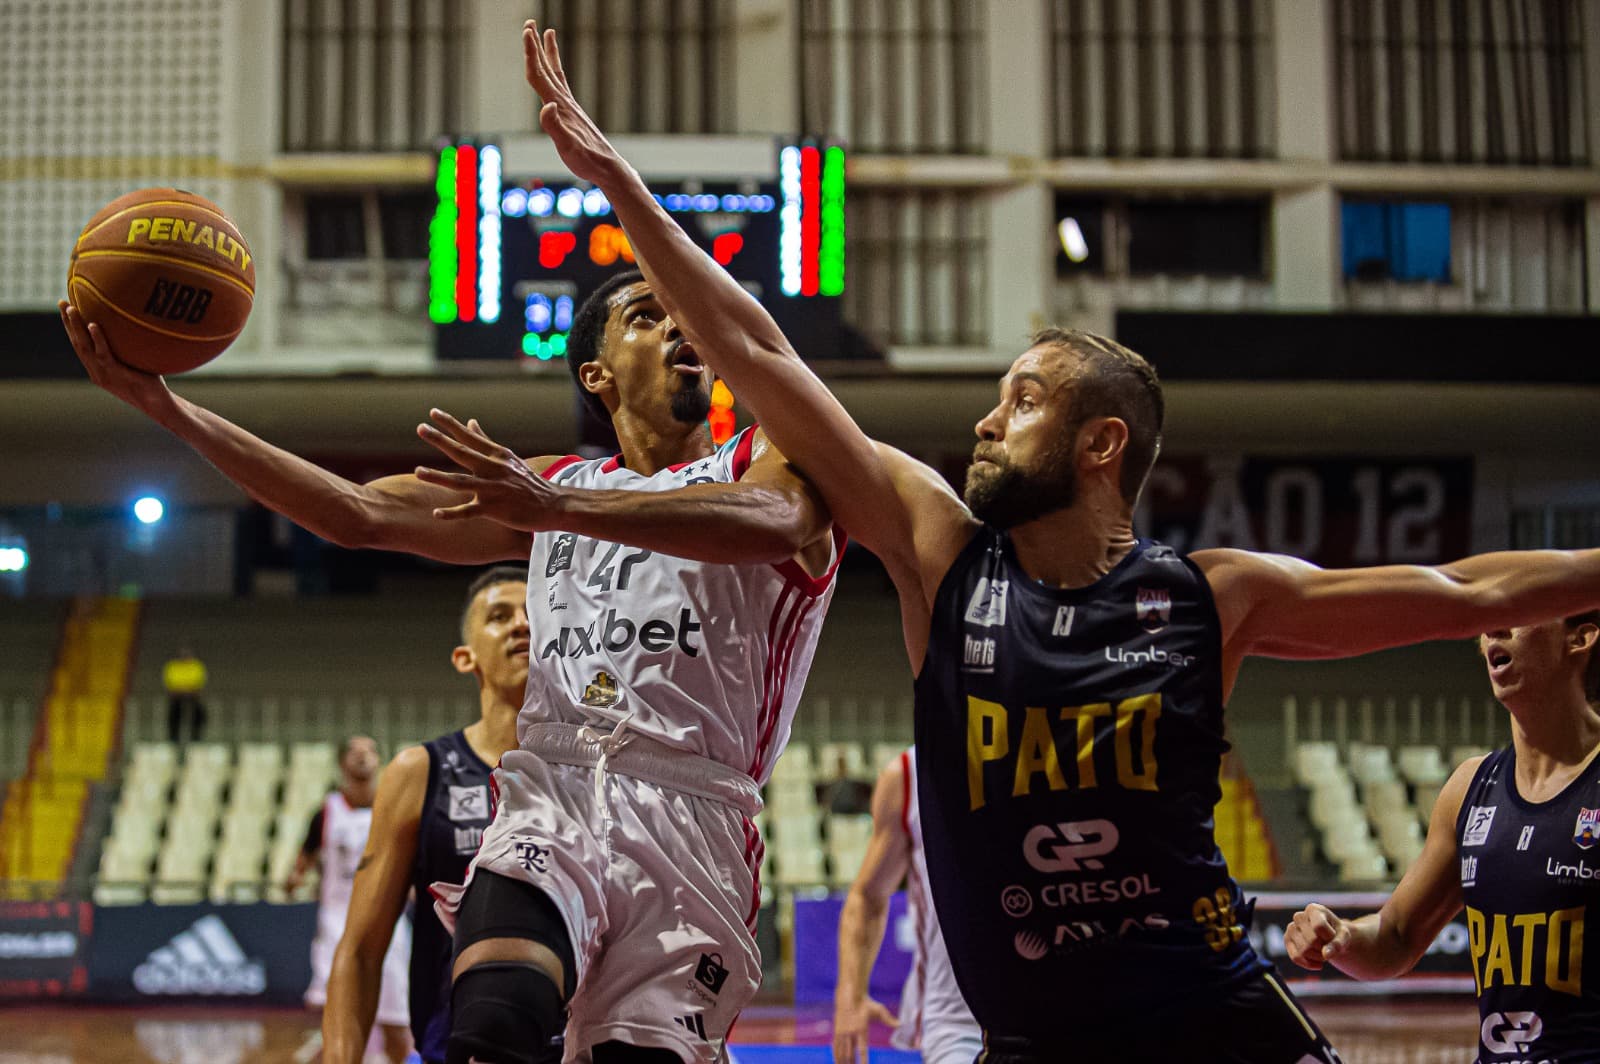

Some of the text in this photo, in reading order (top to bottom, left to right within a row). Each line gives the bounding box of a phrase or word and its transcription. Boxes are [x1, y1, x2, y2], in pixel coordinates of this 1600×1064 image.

[127, 217, 252, 271] PENALTY
[1352, 463, 1447, 563] 12
[1105, 644, 1197, 668] Limber
[966, 692, 1163, 813] PATO
[1041, 873, 1161, 907] CRESOL
[1466, 904, 1586, 998] PATO
